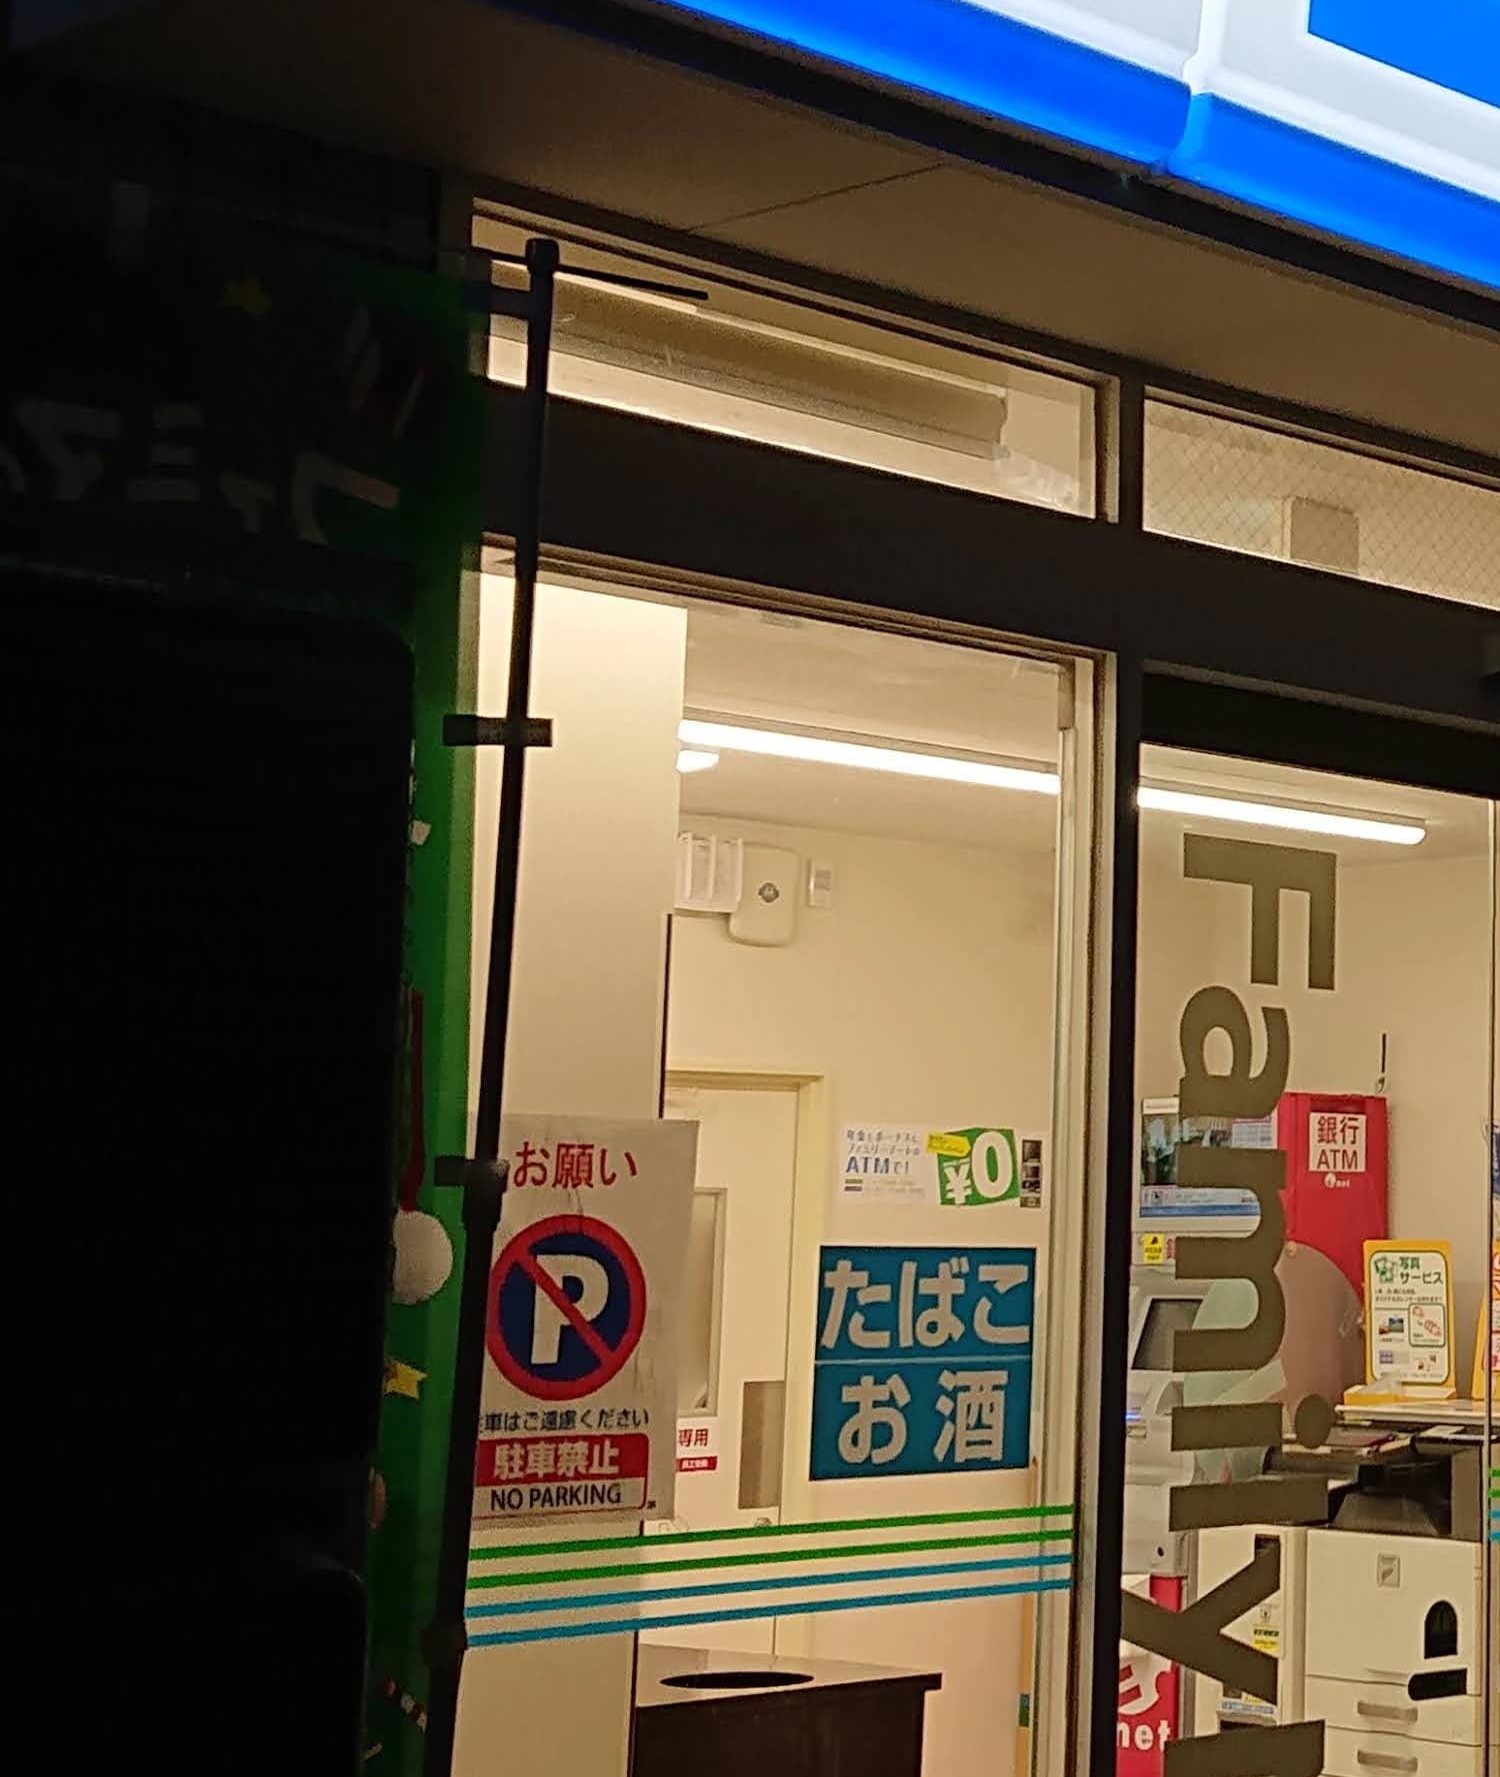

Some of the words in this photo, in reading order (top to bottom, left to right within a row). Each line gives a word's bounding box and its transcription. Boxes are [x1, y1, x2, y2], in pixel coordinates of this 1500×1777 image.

[1317, 1116, 1360, 1145] 銀行
[512, 1140, 638, 1189] お願い
[1317, 1149, 1359, 1170] ATM
[1399, 1256, 1420, 1270] 写真
[1400, 1271, 1443, 1285] サービス
[820, 1256, 1031, 1350] たばこ
[837, 1368, 1009, 1466] お酒
[678, 1428, 708, 1448] 専用
[493, 1439, 621, 1480] 駐車禁止
[491, 1487, 524, 1512] NO
[529, 1483, 622, 1508] PARKING
[1117, 1720, 1172, 1751] net
